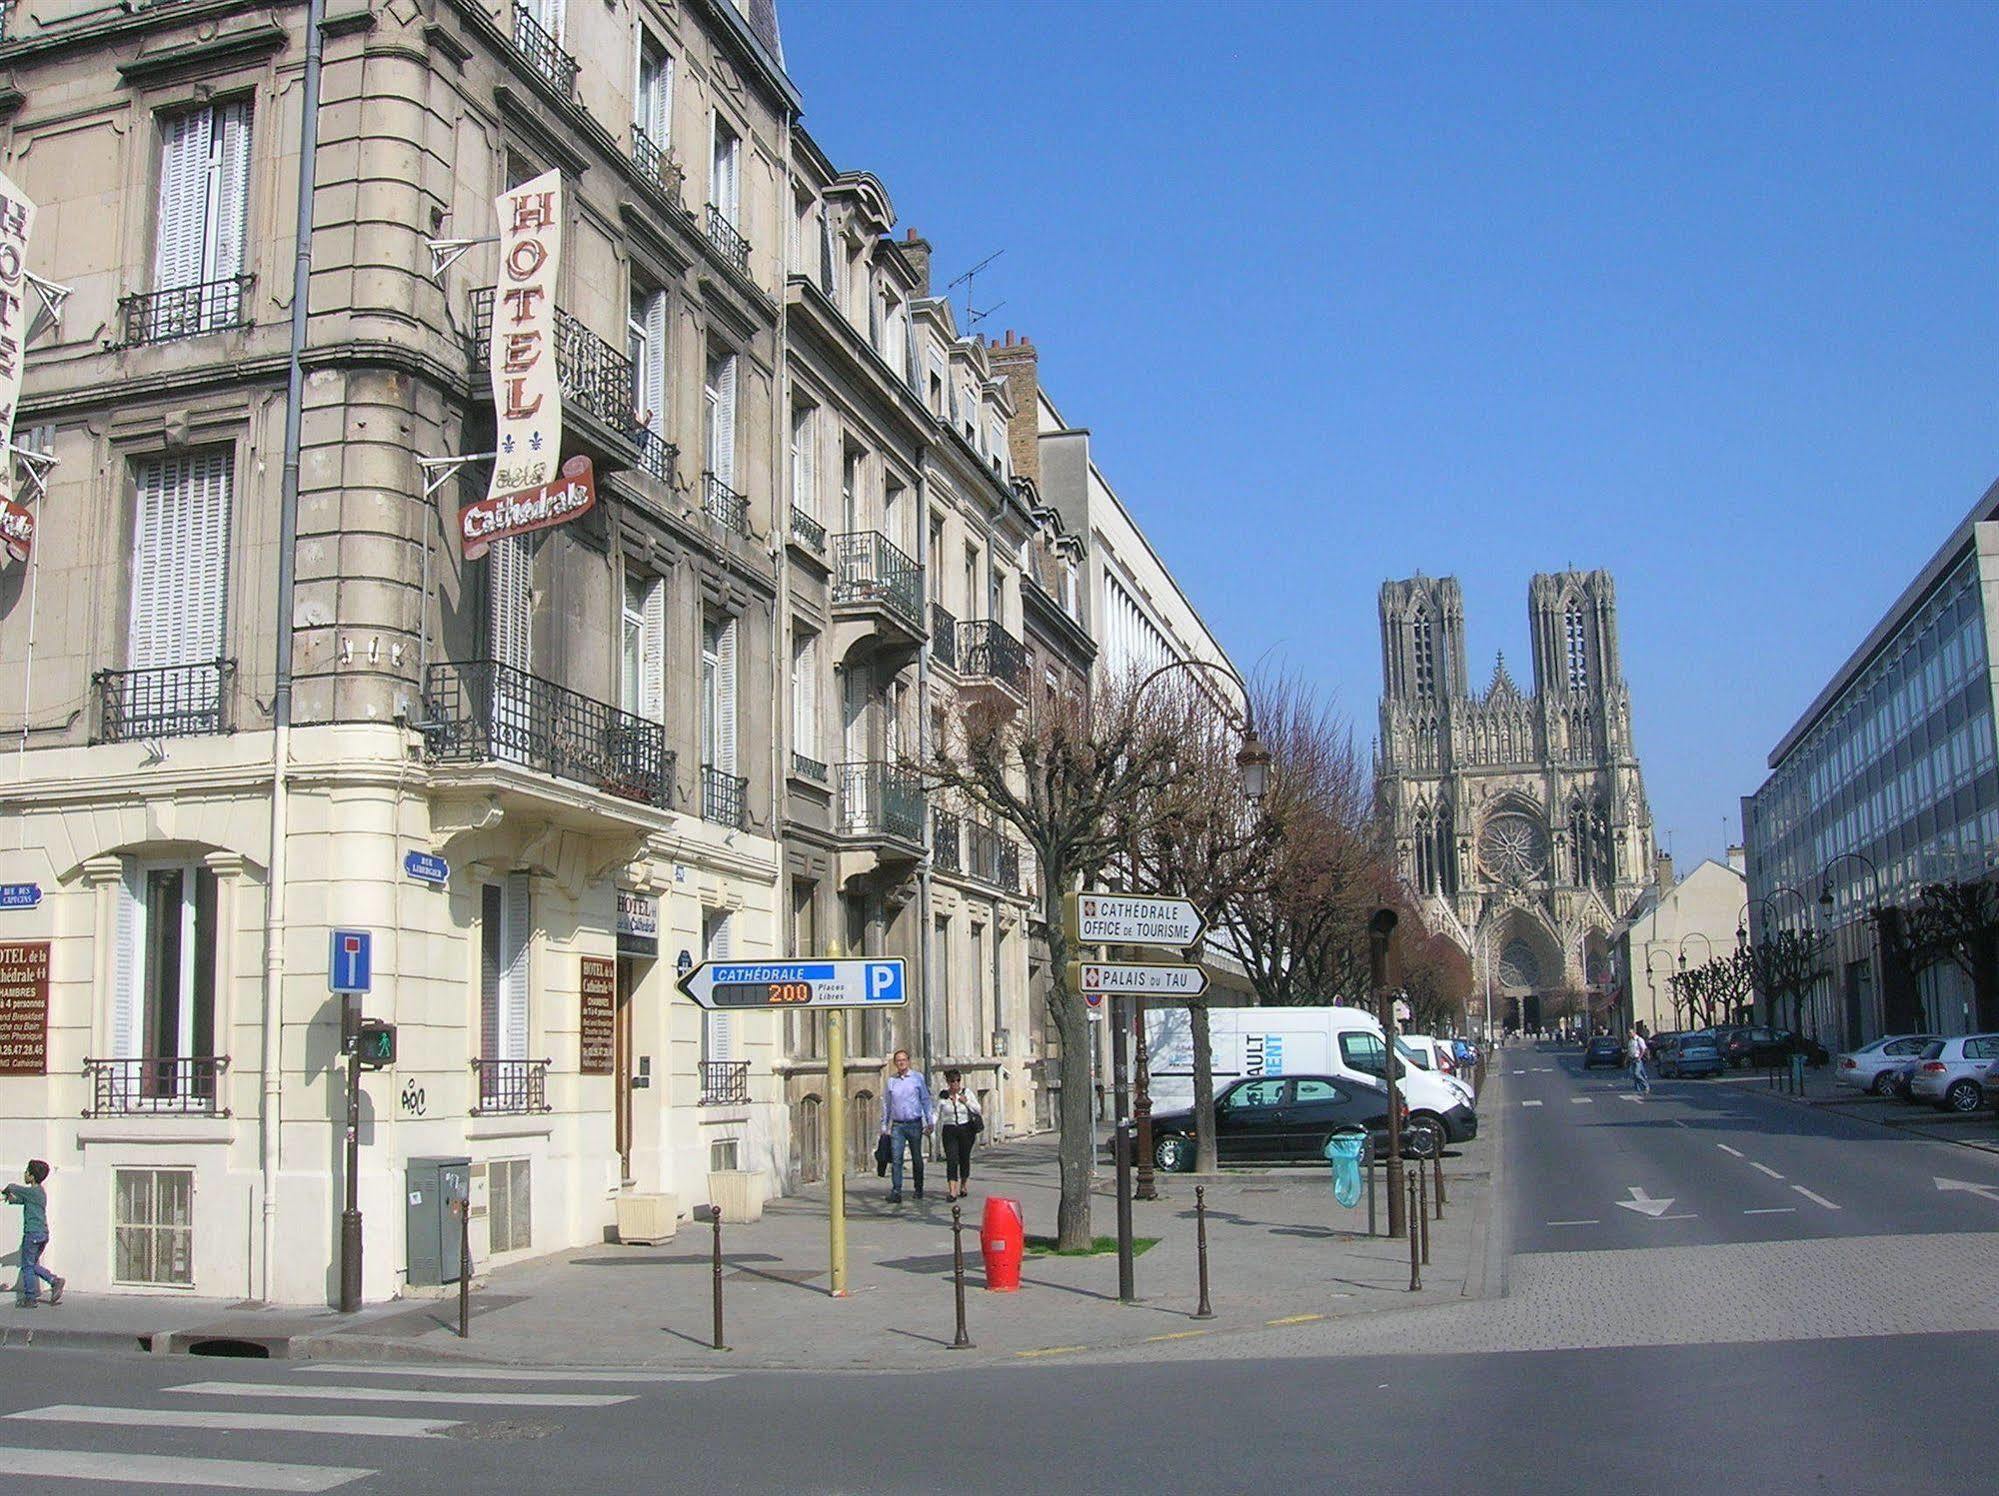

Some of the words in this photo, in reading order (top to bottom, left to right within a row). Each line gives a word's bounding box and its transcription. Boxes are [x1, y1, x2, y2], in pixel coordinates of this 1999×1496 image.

[502, 191, 555, 419] HOTEL
[617, 895, 650, 917] HOTEL
[1101, 902, 1178, 920] CATHÉDRALE
[1084, 921, 1120, 935] OFFICE
[1137, 923, 1189, 938] TOURISME
[718, 966, 804, 981] CATHÉDRALE
[872, 965, 894, 998] P
[818, 983, 845, 992] Places
[1103, 971, 1146, 985] PALAIS
[1166, 973, 1187, 987] TAU
[769, 984, 808, 1003] 200
[818, 992, 845, 1001] Libres
